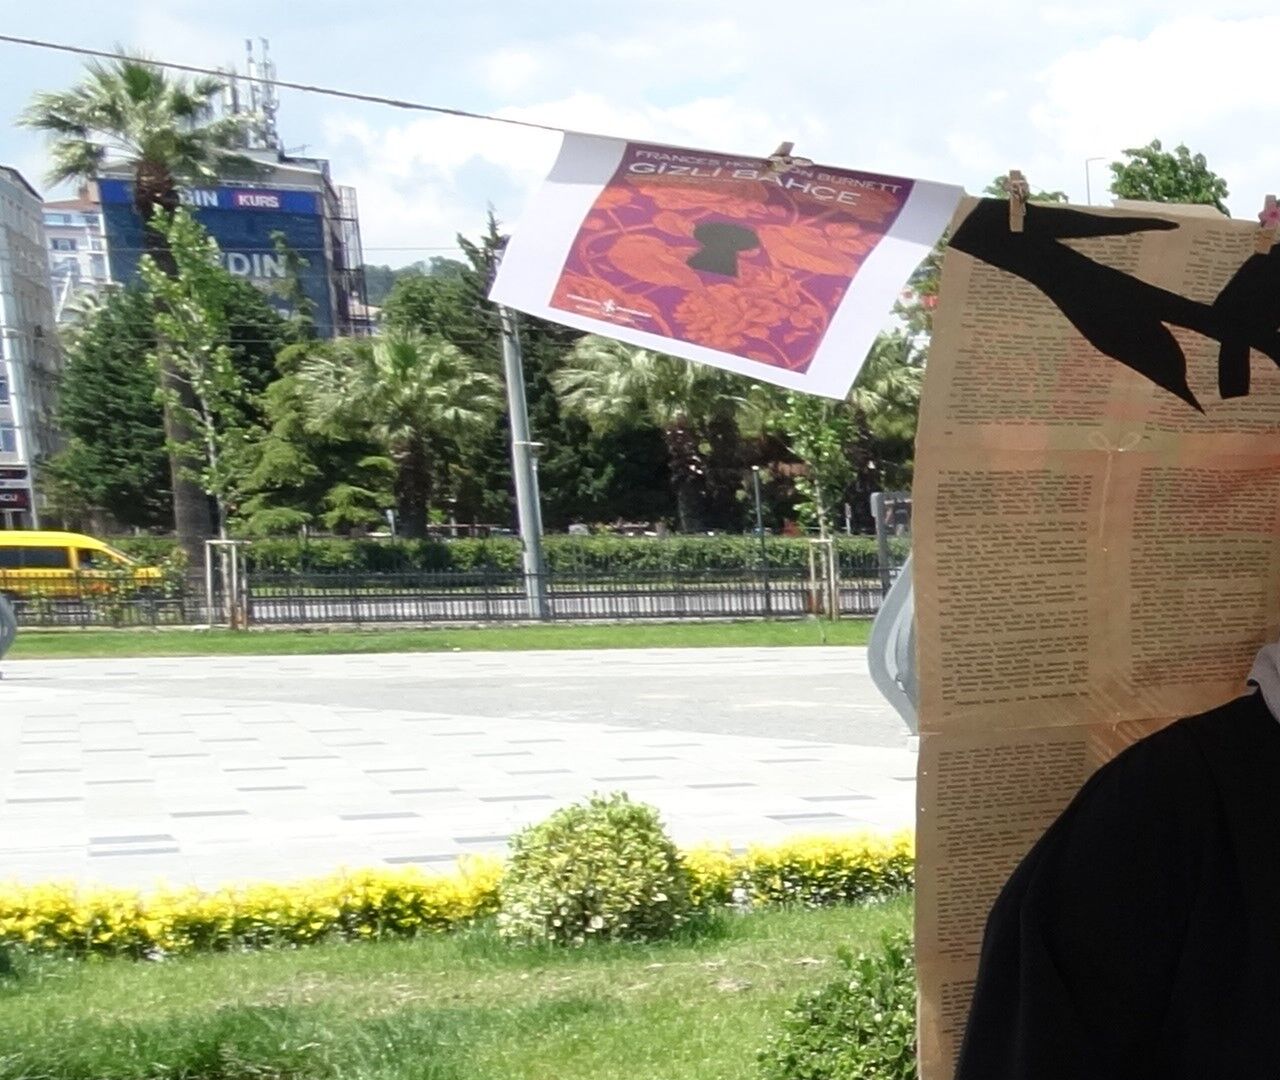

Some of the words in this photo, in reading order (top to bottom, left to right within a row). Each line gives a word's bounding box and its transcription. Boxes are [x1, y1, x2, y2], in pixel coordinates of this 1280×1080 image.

[634, 150, 720, 166] FRANCES
[816, 172, 901, 193] BURNETT
[731, 168, 861, 205] BAHÇE
[238, 194, 280, 209] KURS
